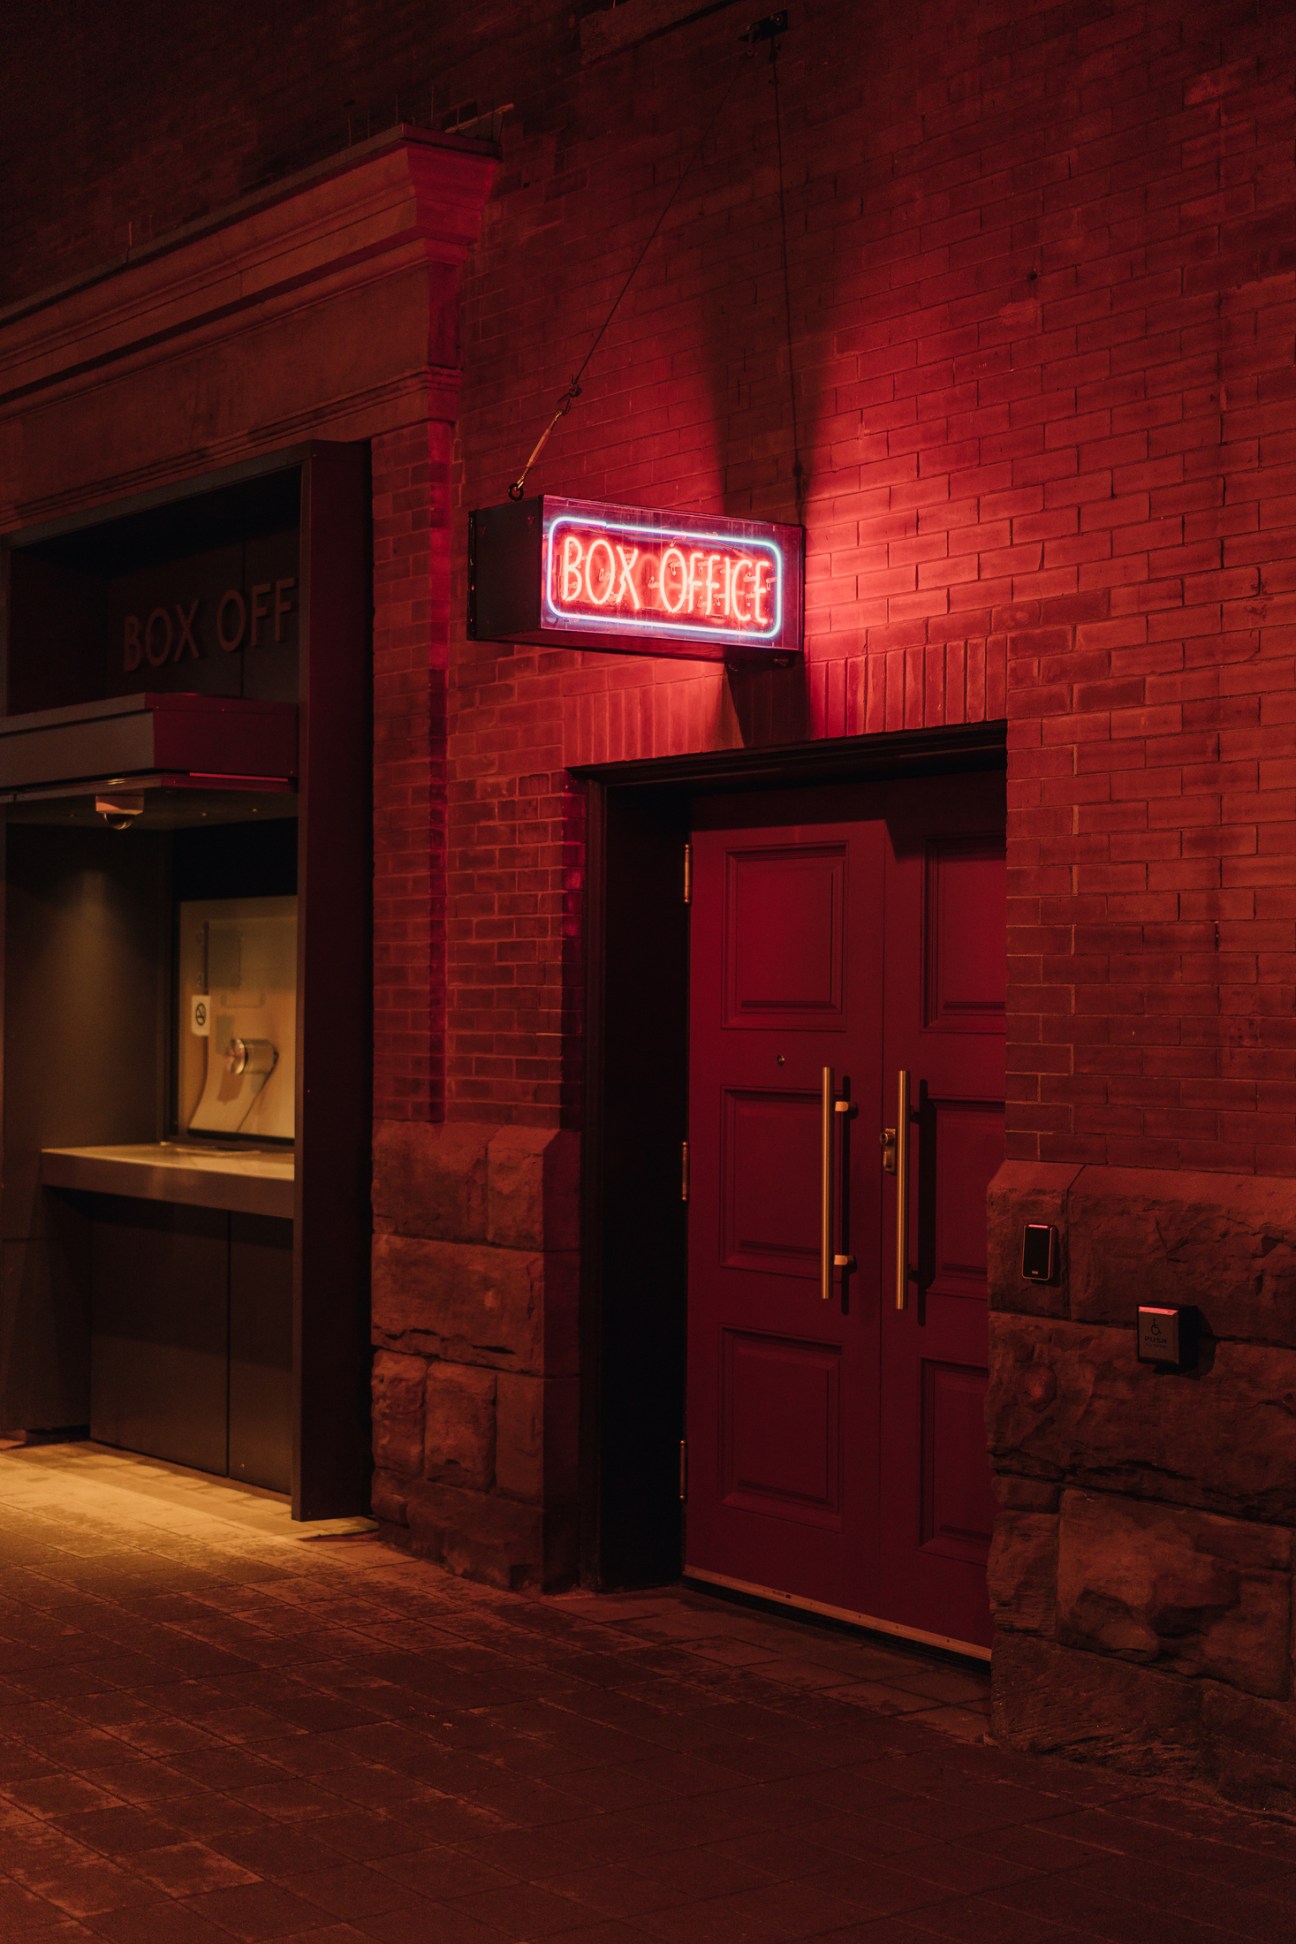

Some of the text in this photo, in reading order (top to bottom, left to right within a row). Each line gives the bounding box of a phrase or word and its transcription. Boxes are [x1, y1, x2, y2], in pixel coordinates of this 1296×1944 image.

[561, 535, 772, 626] BOX OFFICE
[123, 599, 200, 673] BOX
[1144, 1335, 1167, 1344] PUSH
